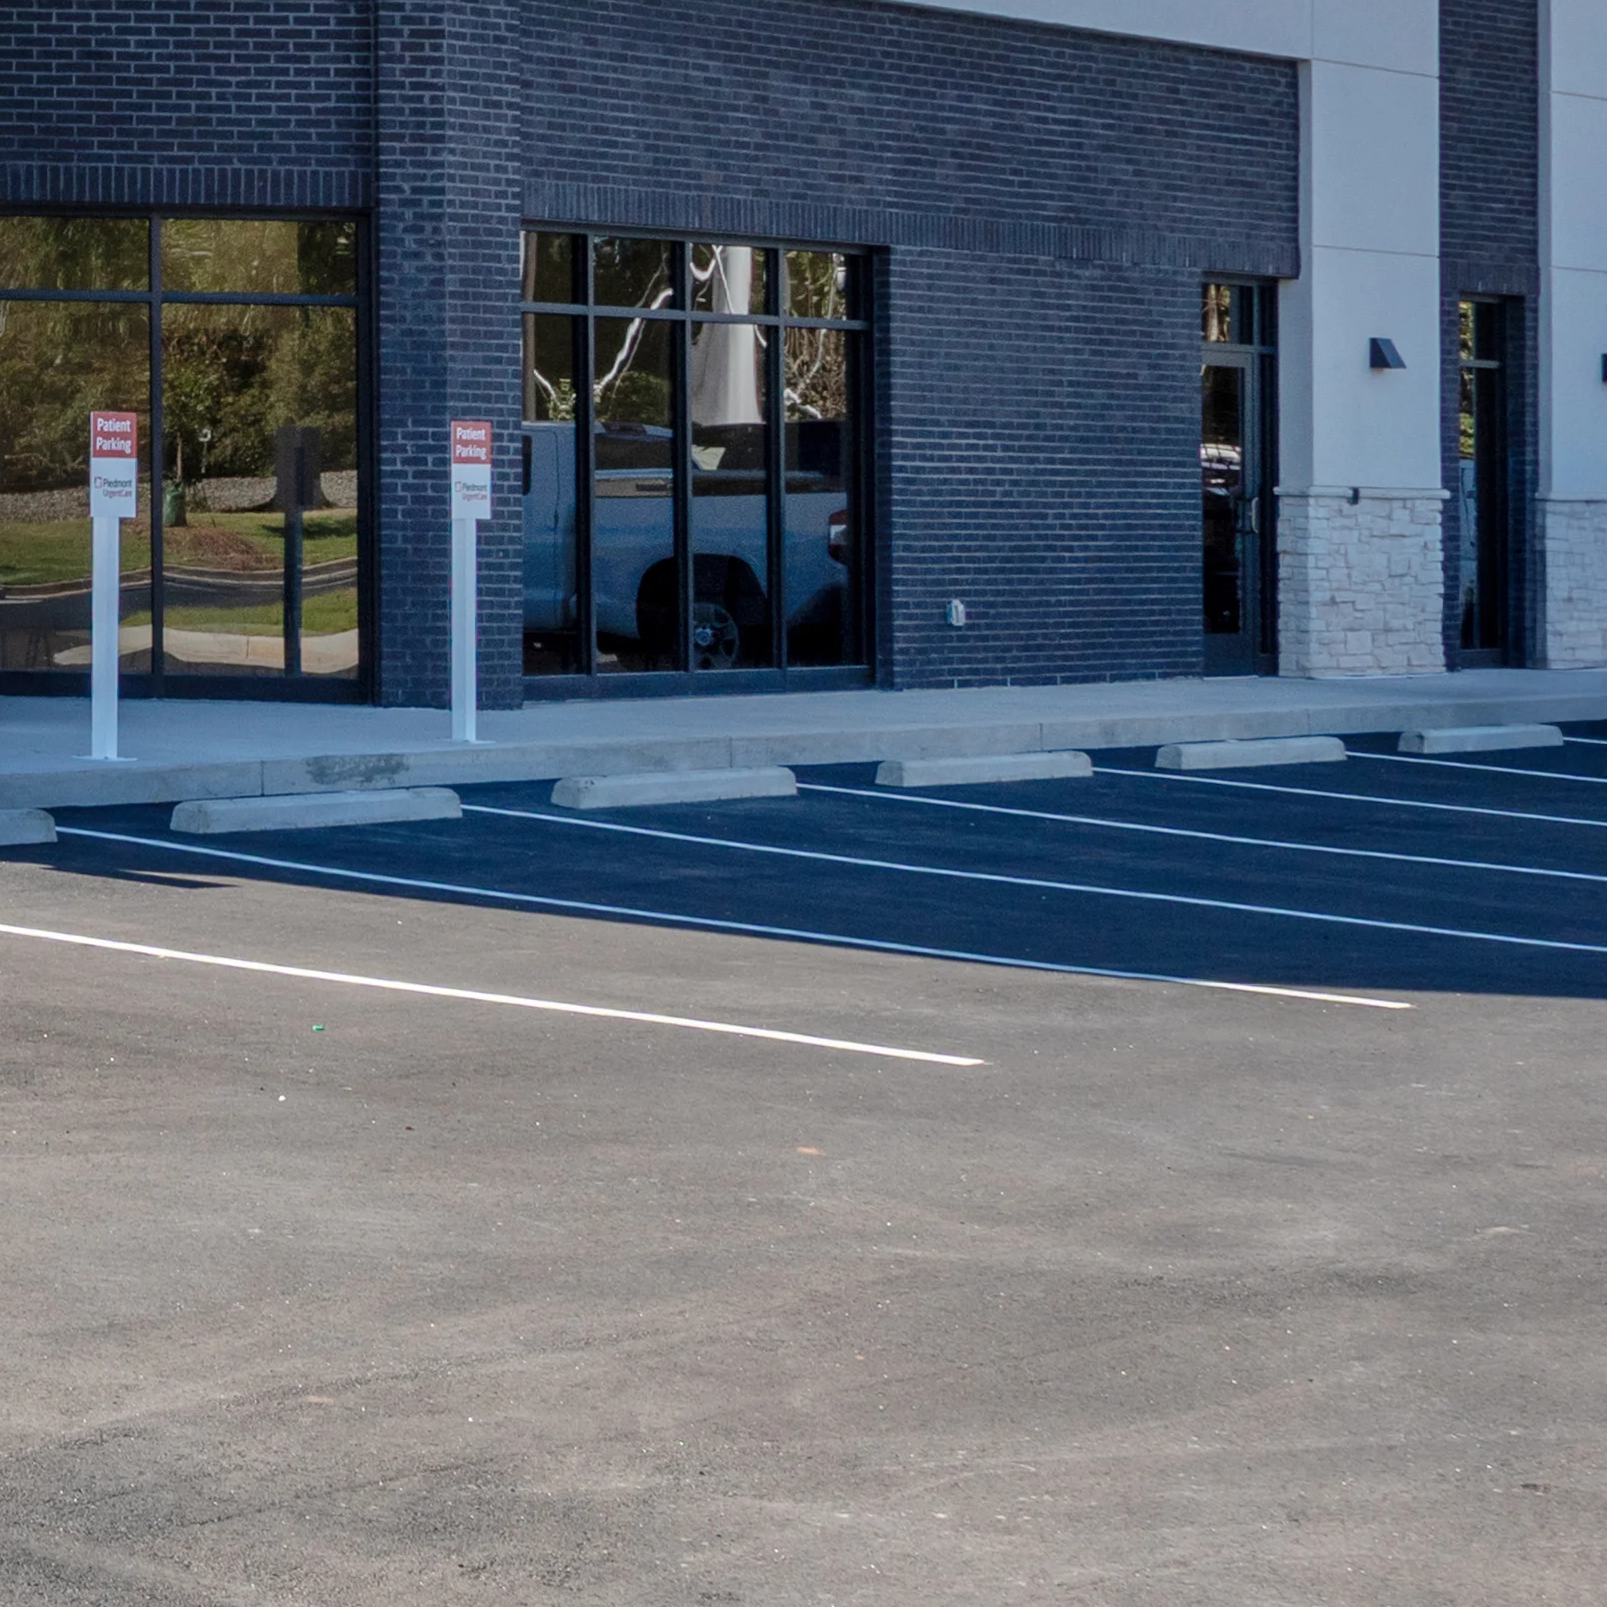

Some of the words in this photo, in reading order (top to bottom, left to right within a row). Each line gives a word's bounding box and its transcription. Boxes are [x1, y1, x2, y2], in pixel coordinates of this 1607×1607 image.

[97, 418, 131, 432] Patient
[456, 427, 486, 440] Patient
[96, 437, 132, 454] Parking
[455, 444, 487, 460] Parking
